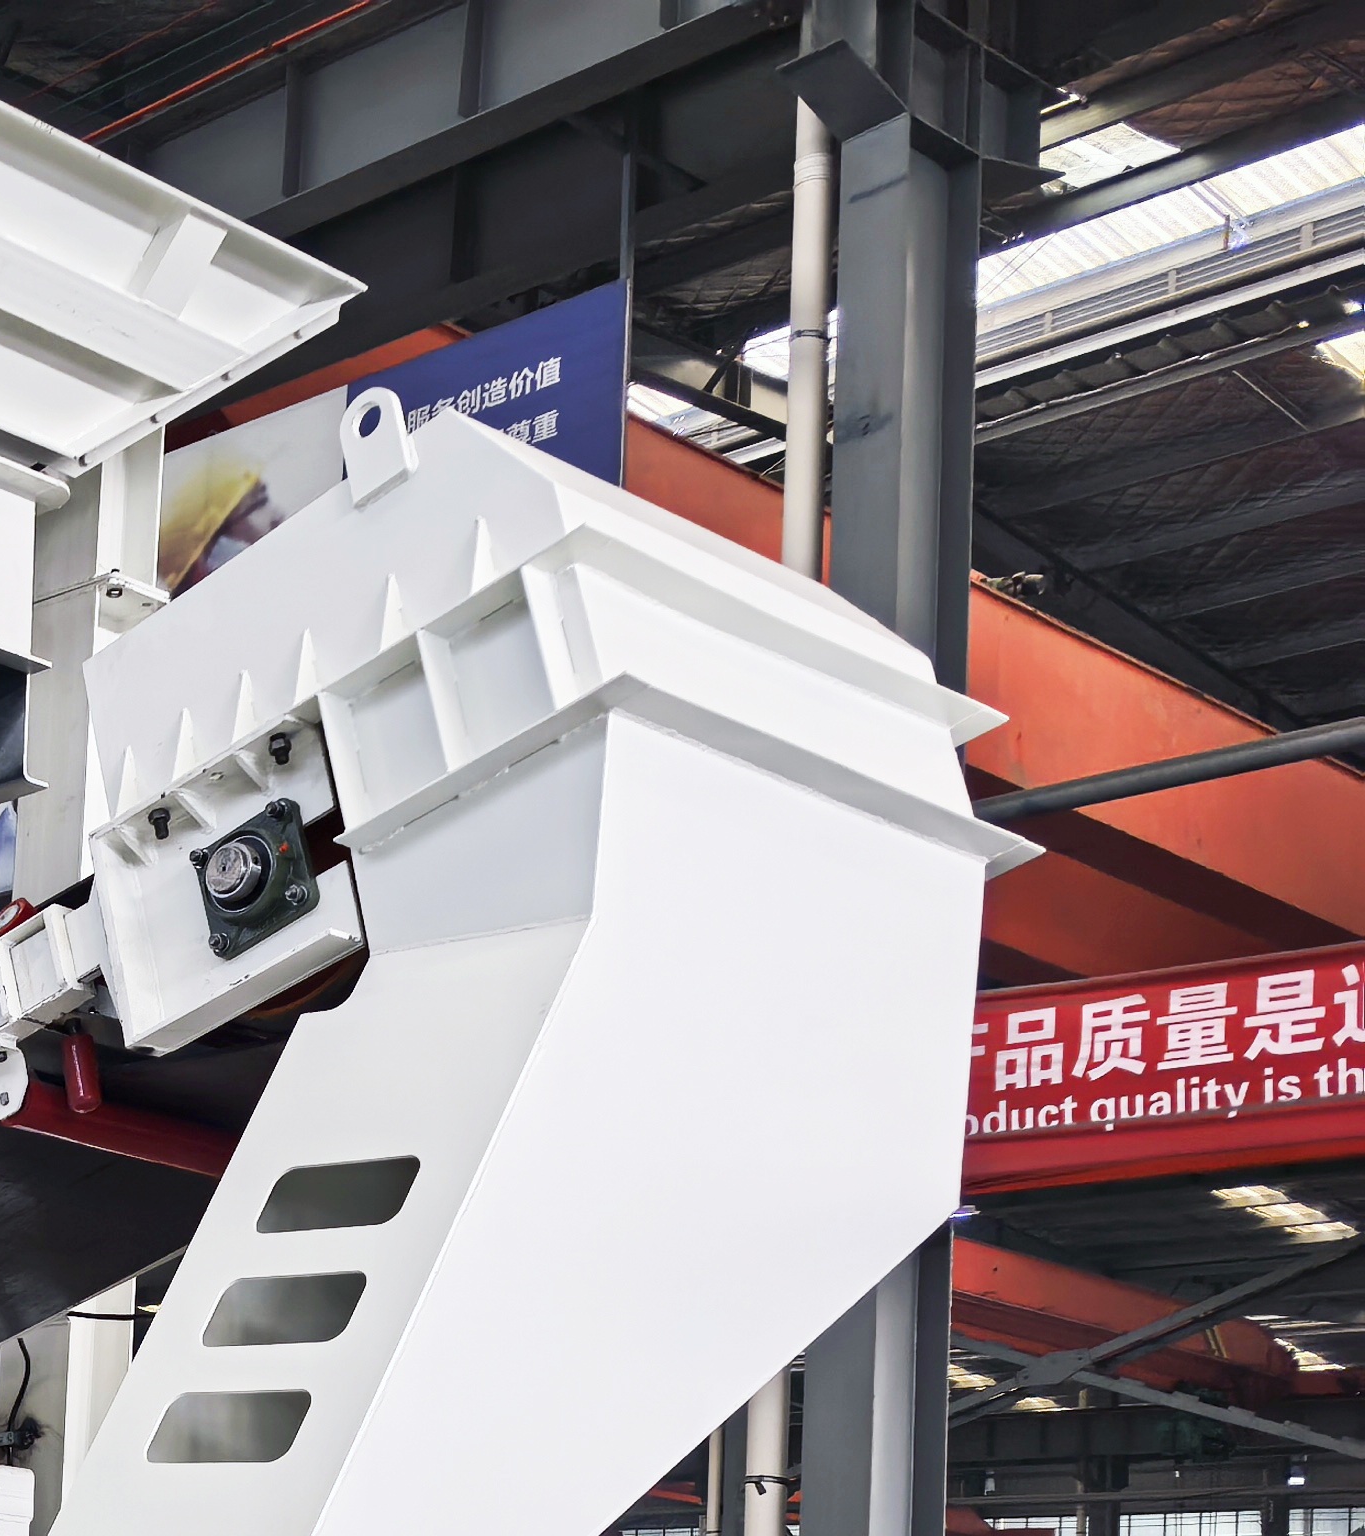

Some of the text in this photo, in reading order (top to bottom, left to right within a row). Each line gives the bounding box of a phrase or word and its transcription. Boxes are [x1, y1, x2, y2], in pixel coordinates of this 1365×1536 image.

[498, 409, 560, 444] 尊重
[971, 964, 1365, 1092] 品质量是
[1089, 1076, 1250, 1132] quality
[1263, 1066, 1303, 1104] is
[1313, 1057, 1365, 1098] th
